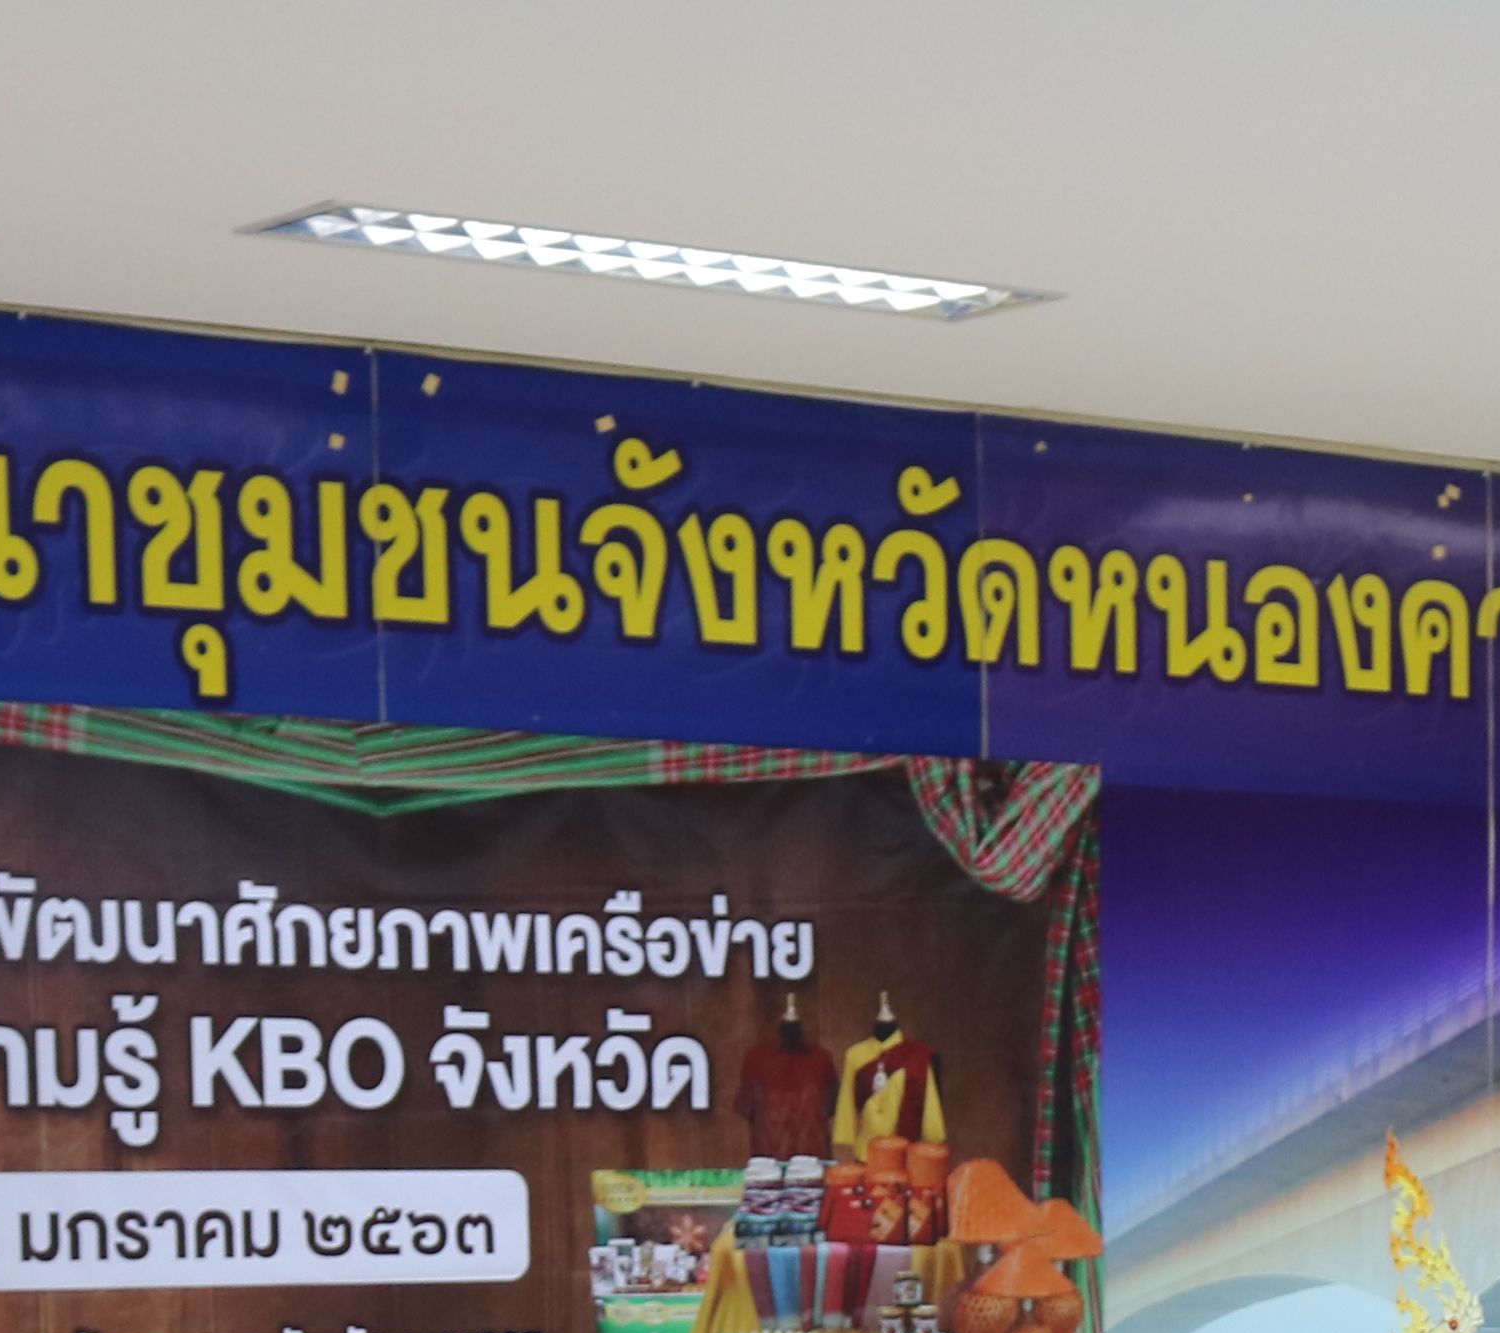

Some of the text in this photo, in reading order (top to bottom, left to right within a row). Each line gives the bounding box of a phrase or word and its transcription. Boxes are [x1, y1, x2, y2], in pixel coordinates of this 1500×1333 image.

[189, 1015, 406, 1110] KBO
[428, 1004, 711, 1112] จังหวัด
[19, 1207, 280, 1262] มกราคม
[302, 1205, 495, 1257] ๒๕๖๓
